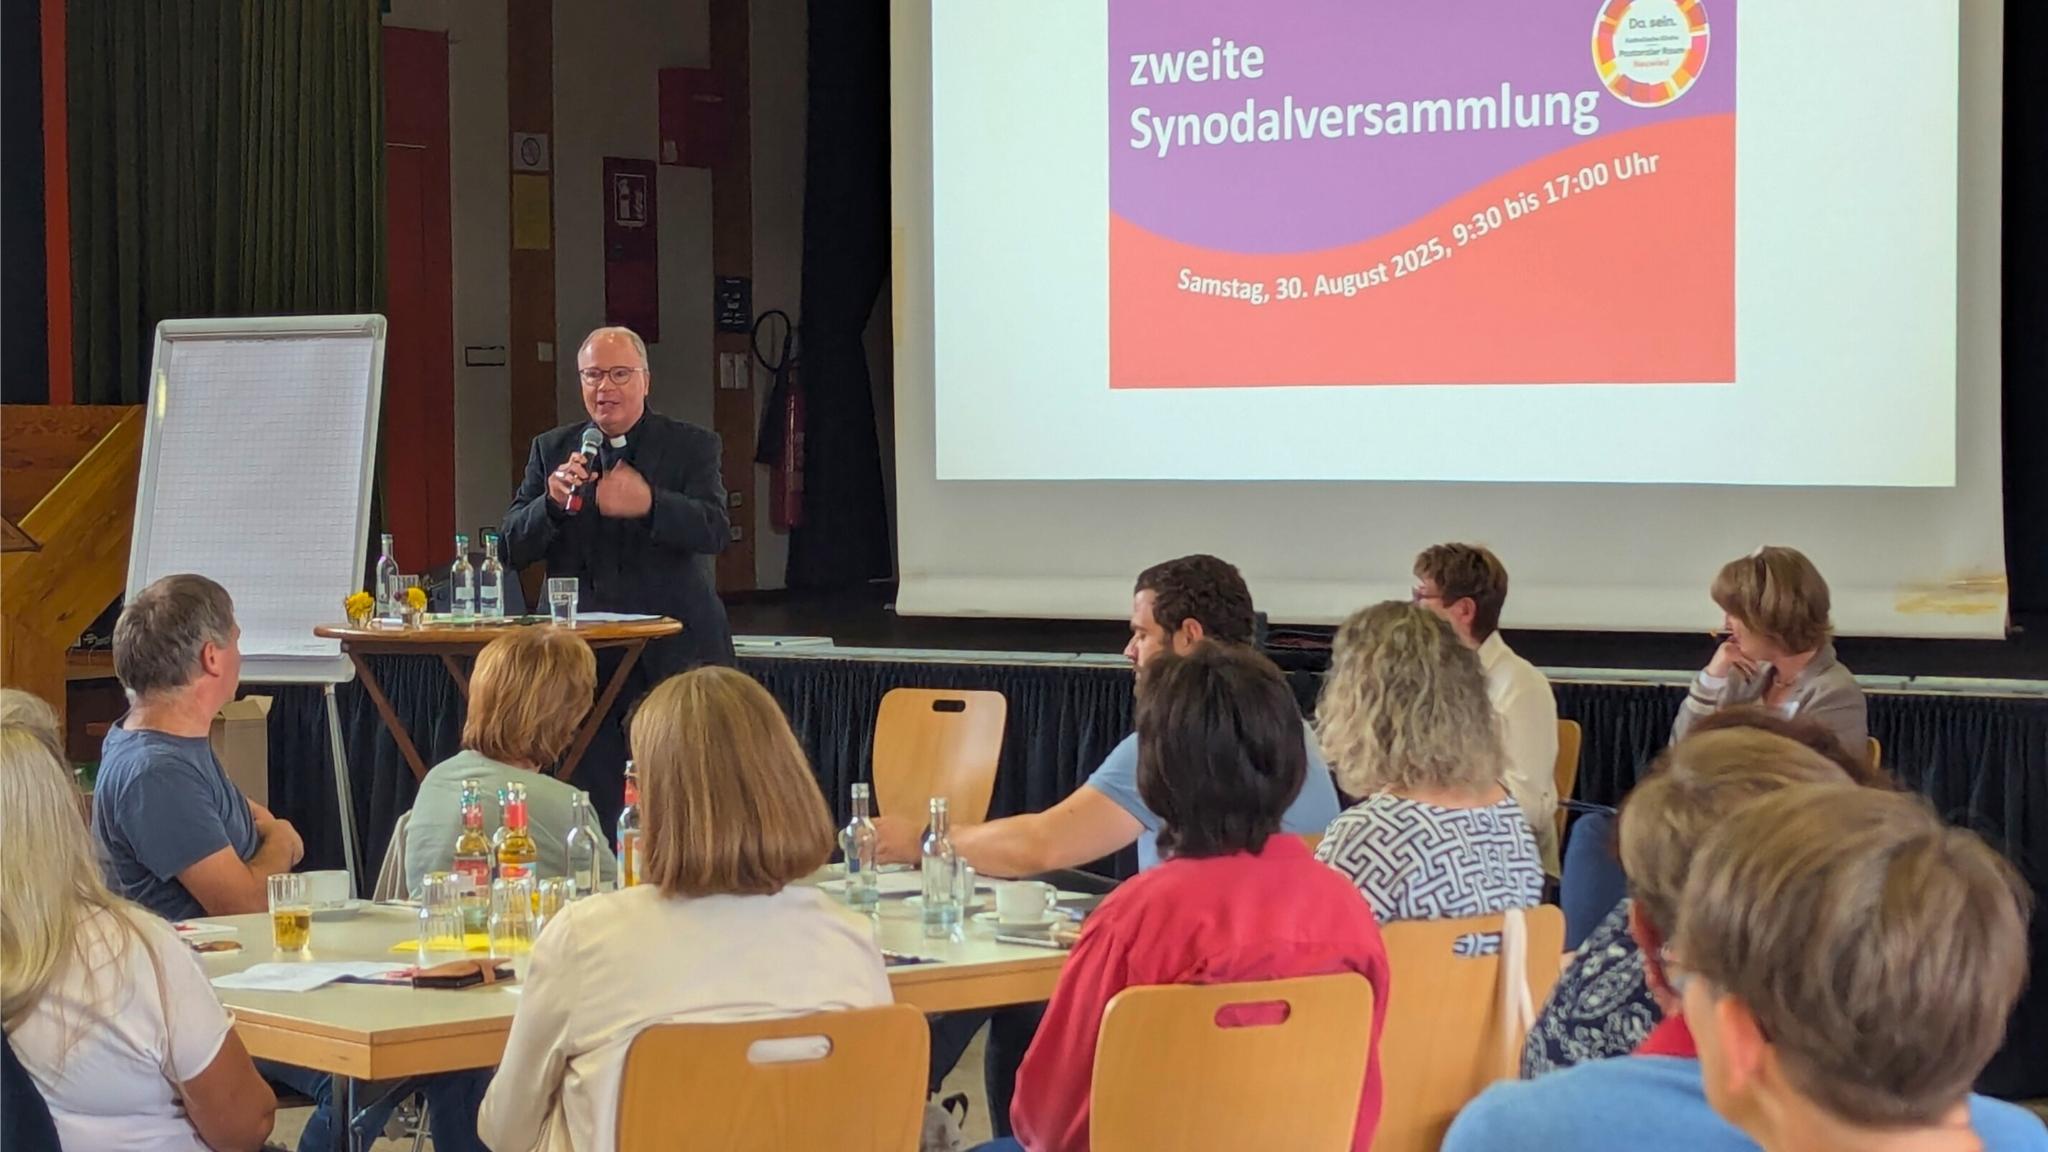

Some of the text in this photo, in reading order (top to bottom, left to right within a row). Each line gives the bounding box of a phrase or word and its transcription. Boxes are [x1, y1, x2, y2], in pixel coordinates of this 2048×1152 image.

[1130, 36, 1265, 86] zweite
[1130, 82, 1600, 158] Synodalversammlung
[1177, 152, 1659, 304] Samstag, 30. August 2025, 9:30 bis 17:00 Uhr
